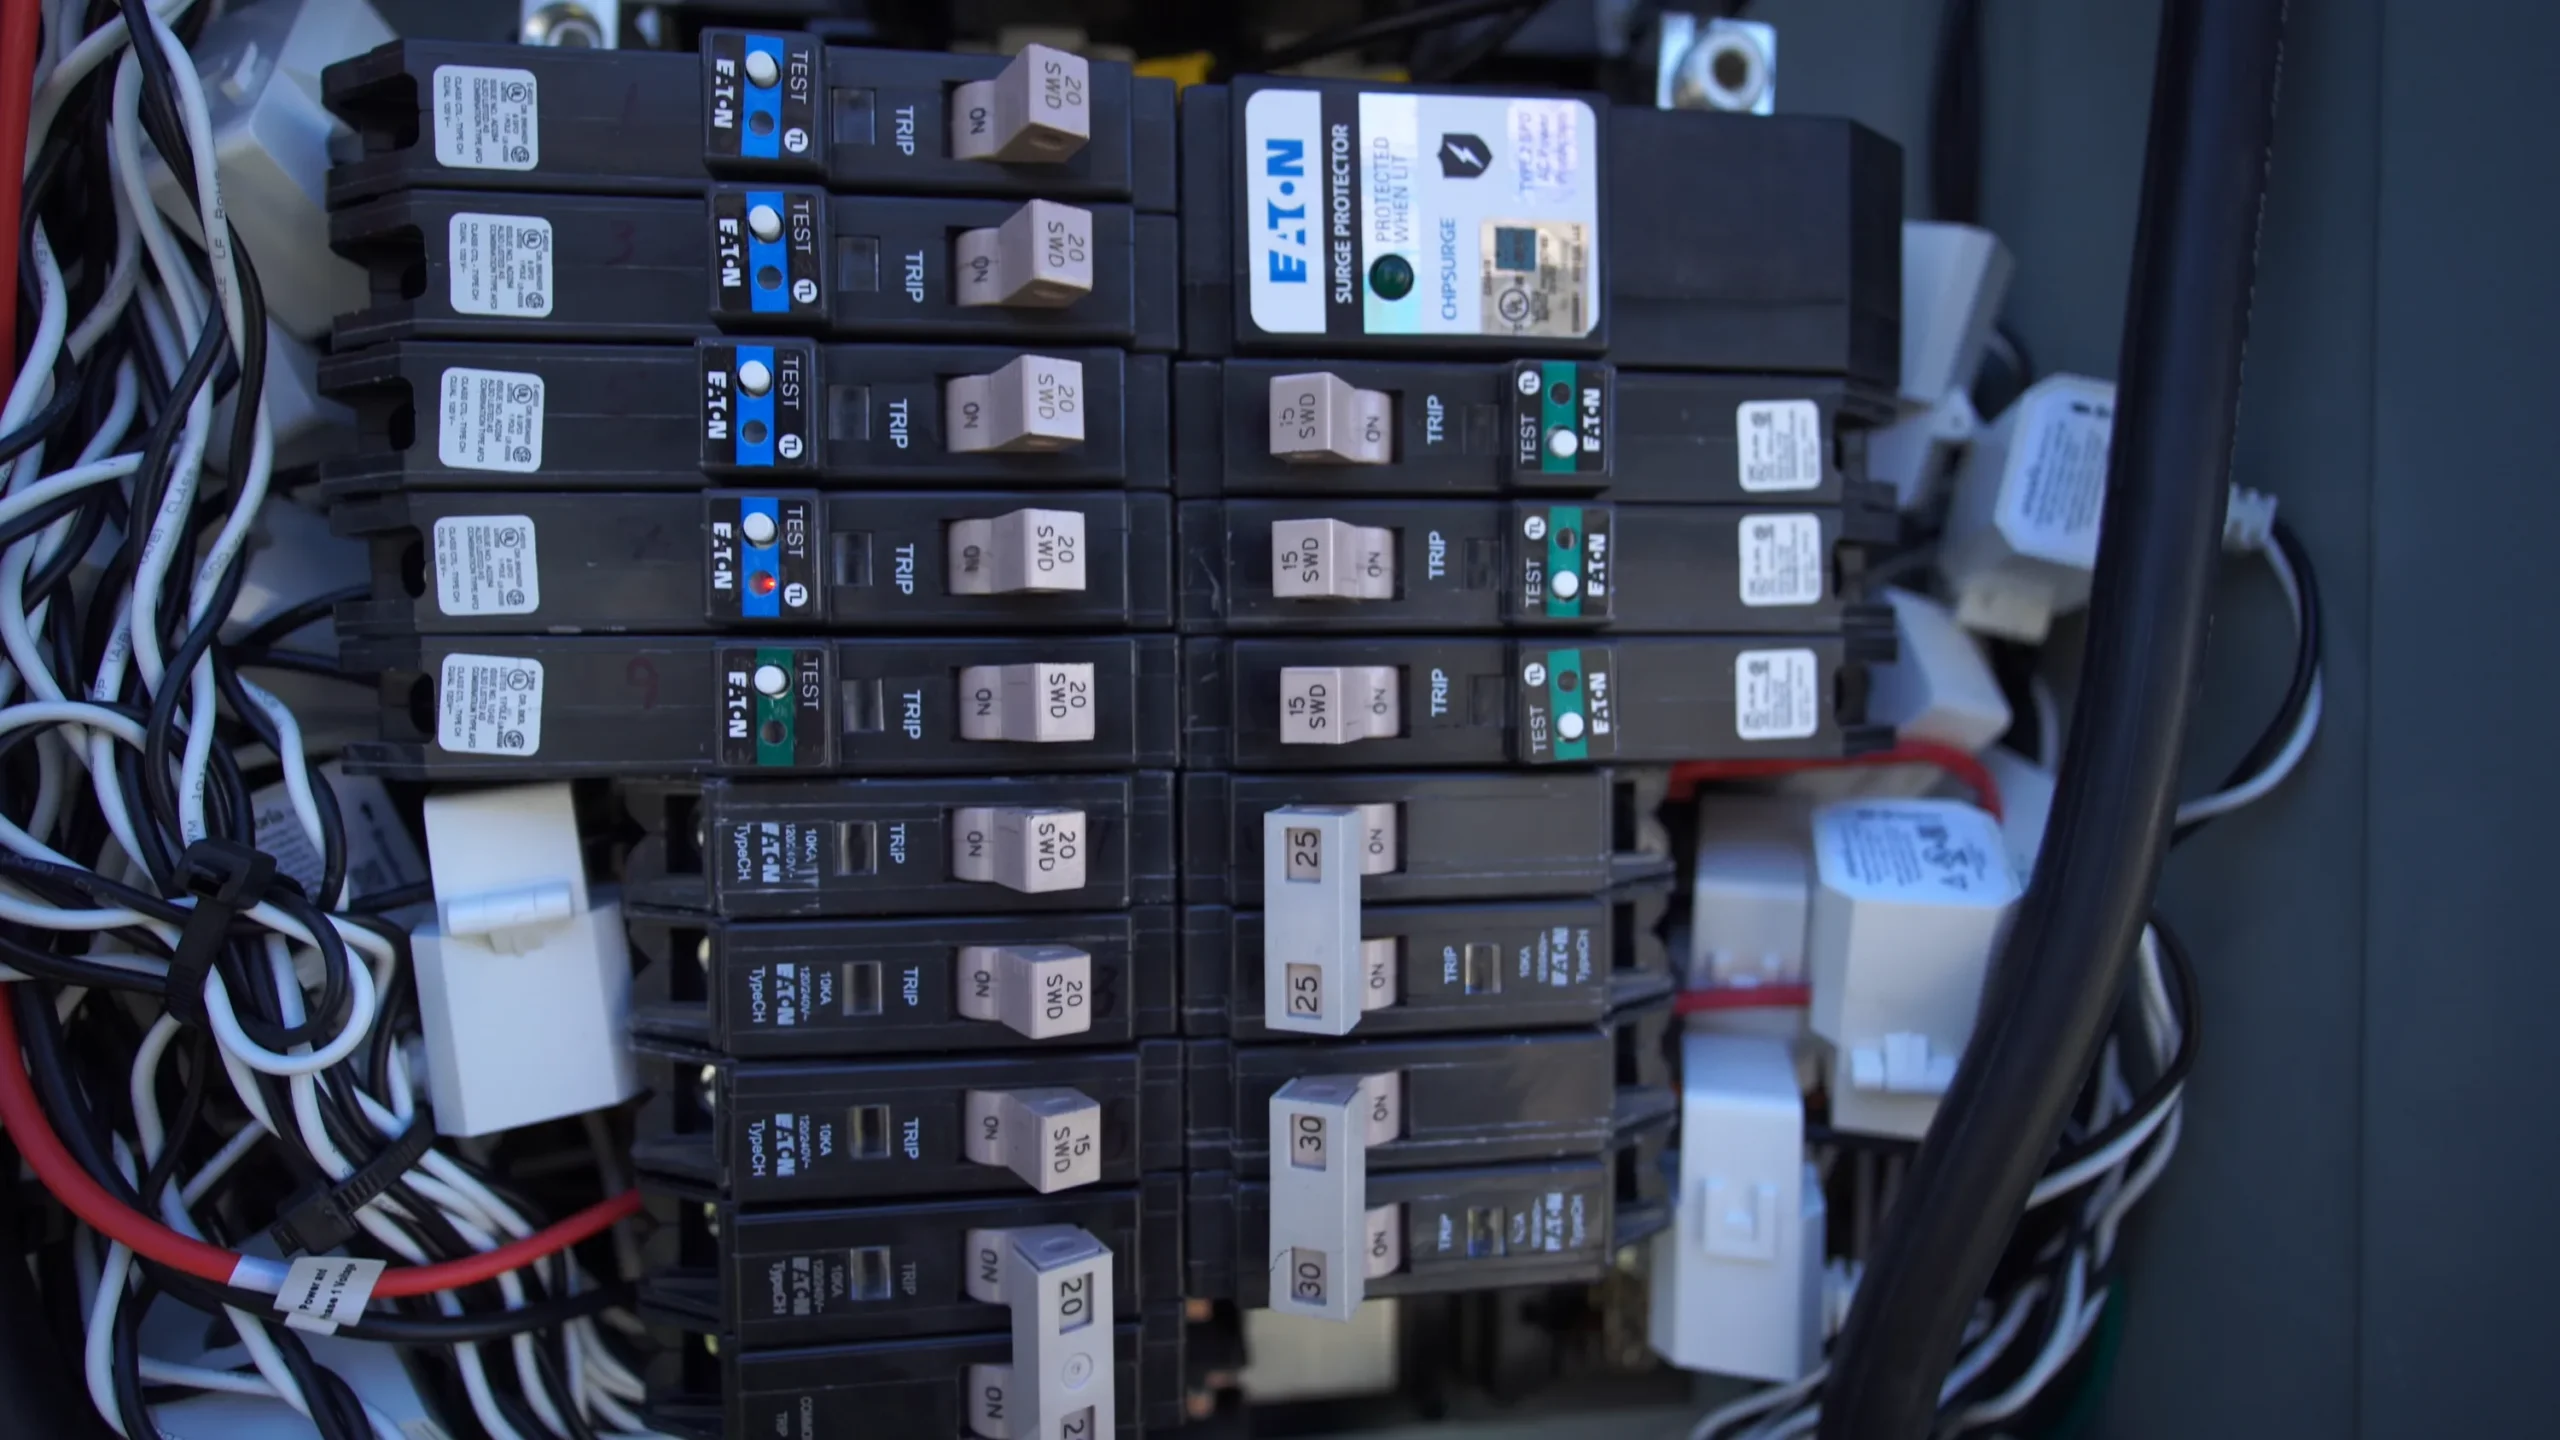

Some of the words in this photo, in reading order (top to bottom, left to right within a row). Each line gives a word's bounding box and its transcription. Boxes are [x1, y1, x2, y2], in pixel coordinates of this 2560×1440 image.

[791, 50, 809, 104] TEST
[1045, 62, 1061, 109] SWD
[1066, 76, 1082, 106] 20
[896, 106, 914, 156] TRIP
[970, 108, 985, 135] ON
[1332, 124, 1349, 239] PROTECTOR
[1393, 155, 1408, 185] LIT
[1375, 136, 1391, 243] PROTECTED
[793, 201, 811, 254] TEST
[1393, 188, 1409, 244] WHEN
[1048, 222, 1065, 268] SWD
[1068, 234, 1084, 262] 20
[906, 250, 923, 302] TRIP
[972, 256, 989, 283] ON
[1334, 240, 1352, 304] SURGE
[1440, 217, 1457, 321] CHPSURGE
[782, 356, 799, 409] TEST
[1039, 374, 1055, 419] SWD
[1059, 386, 1074, 413] 20
[890, 399, 908, 449] TRIP
[963, 403, 980, 429] ON
[1299, 393, 1315, 439] SWD
[1366, 416, 1380, 442] ON
[1427, 394, 1444, 444] TRIP
[1520, 413, 1537, 463] TEST
[787, 505, 803, 558] TEST
[1037, 526, 1054, 572] SWD
[1058, 536, 1074, 563] 20
[896, 543, 914, 594] TRIP
[964, 545, 980, 572] ON
[1281, 550, 1298, 572] 15
[1302, 537, 1318, 583] SWD
[1368, 552, 1382, 578] ON
[1428, 531, 1446, 580] TRIP
[1525, 558, 1541, 608] TEST
[803, 658, 819, 710] TEST
[976, 688, 992, 716] ON
[1050, 673, 1066, 719] SWD
[1070, 681, 1086, 708] 20
[1372, 688, 1387, 715] ON
[1431, 668, 1448, 717] TRIP
[903, 690, 921, 739] TRIP
[1288, 696, 1306, 716] 15
[1309, 684, 1326, 729] SWD
[1529, 704, 1547, 754] TEST
[805, 829, 816, 862] 10KA
[890, 824, 905, 863] TRIP
[967, 831, 983, 858] ON
[1039, 823, 1055, 872] SWD
[1059, 831, 1076, 859] 20
[1295, 831, 1318, 868] 25
[1369, 828, 1383, 854] ON
[974, 970, 990, 998] ON
[1370, 963, 1384, 989] ON
[1443, 946, 1457, 984] TRIP
[749, 967, 766, 1023] TypeCH
[820, 971, 832, 1005] 10KA
[904, 967, 919, 1006] TRIP
[1047, 974, 1063, 1020] SWD
[1066, 980, 1083, 1007] 20
[1296, 975, 1318, 1012] 25
[1373, 1094, 1387, 1120] ON
[820, 1123, 832, 1156] 10KA
[904, 1117, 919, 1160] TRIP
[983, 1116, 999, 1141] ON
[1074, 1134, 1090, 1156] 15
[1300, 1115, 1322, 1152] 30
[749, 1119, 766, 1177] TypeCH
[1053, 1126, 1071, 1173] SWD
[1373, 1231, 1387, 1257] ON
[901, 1262, 916, 1295] TRIP
[981, 1249, 999, 1284] ON
[1299, 1262, 1321, 1297] 30
[298, 1281, 320, 1310] Power
[315, 1268, 328, 1281] and
[1061, 1278, 1082, 1316] 20
[985, 1386, 1003, 1419] ON
[1064, 1419, 1085, 1440] 2
